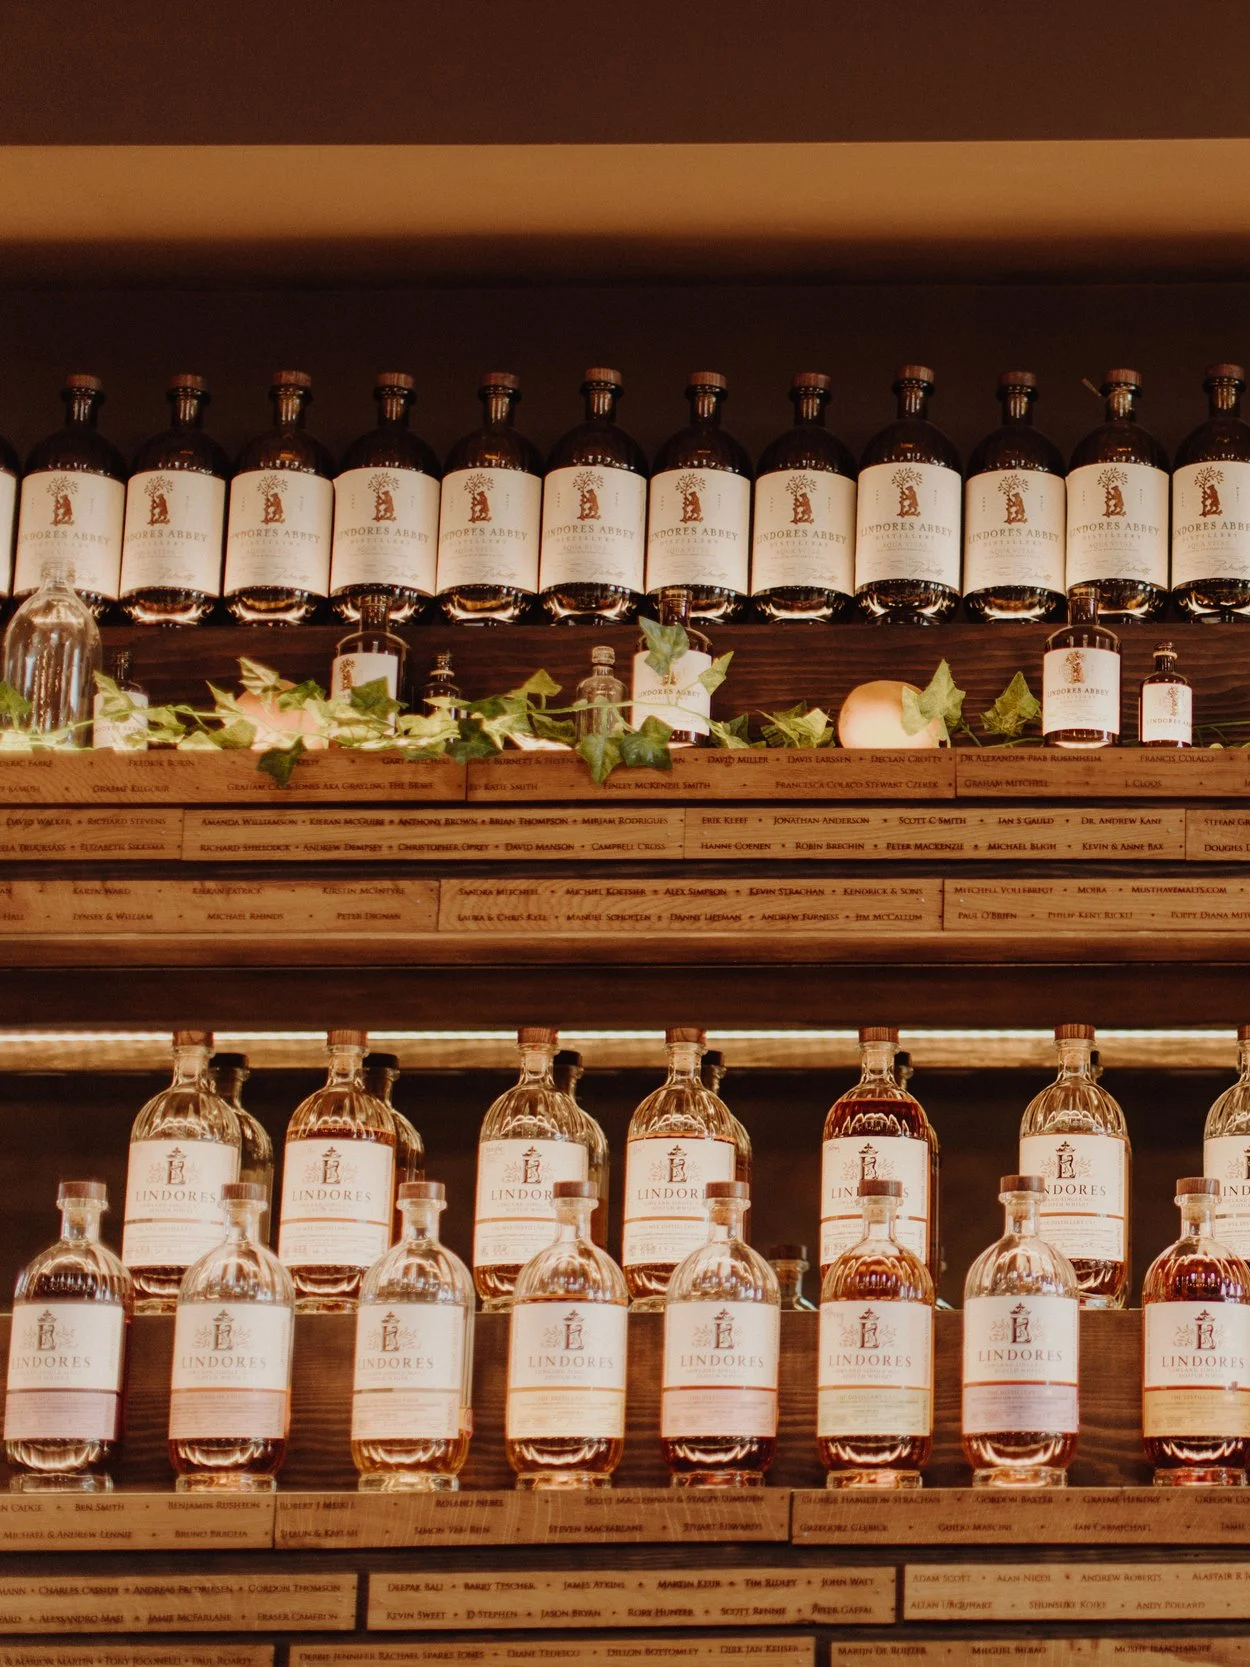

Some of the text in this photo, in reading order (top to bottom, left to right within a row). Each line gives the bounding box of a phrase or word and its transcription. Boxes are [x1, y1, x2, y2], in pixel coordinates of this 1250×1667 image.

[169, 528, 208, 542] ABBEY
[281, 529, 321, 543] ABBEY
[393, 528, 430, 543] ABBEY
[490, 528, 528, 541] ABBEY
[599, 525, 635, 540] ABBEY
[701, 527, 738, 541] ABBEY
[811, 528, 848, 543] ABBEY
[919, 523, 952, 537] ABBEY
[1026, 529, 1060, 543] ABBEY
[1125, 522, 1160, 536] ABBEY
[72, 530, 111, 545] ABBEY
[135, 1190, 217, 1203] LINDORES
[291, 1190, 373, 1202] LINDORES
[490, 1189, 552, 1200] LINDOR
[637, 1188, 706, 1200] LINDOR
[831, 1187, 909, 1199] LINS
[1043, 1184, 1107, 1196] NDORES
[181, 1354, 267, 1369] LINDORES
[528, 1355, 614, 1369] LINDORES
[680, 1354, 765, 1368] LINDORES
[828, 1354, 912, 1368] LINDORES
[978, 1348, 1063, 1363] LINDORES
[1161, 1354, 1245, 1369] LINDORES
